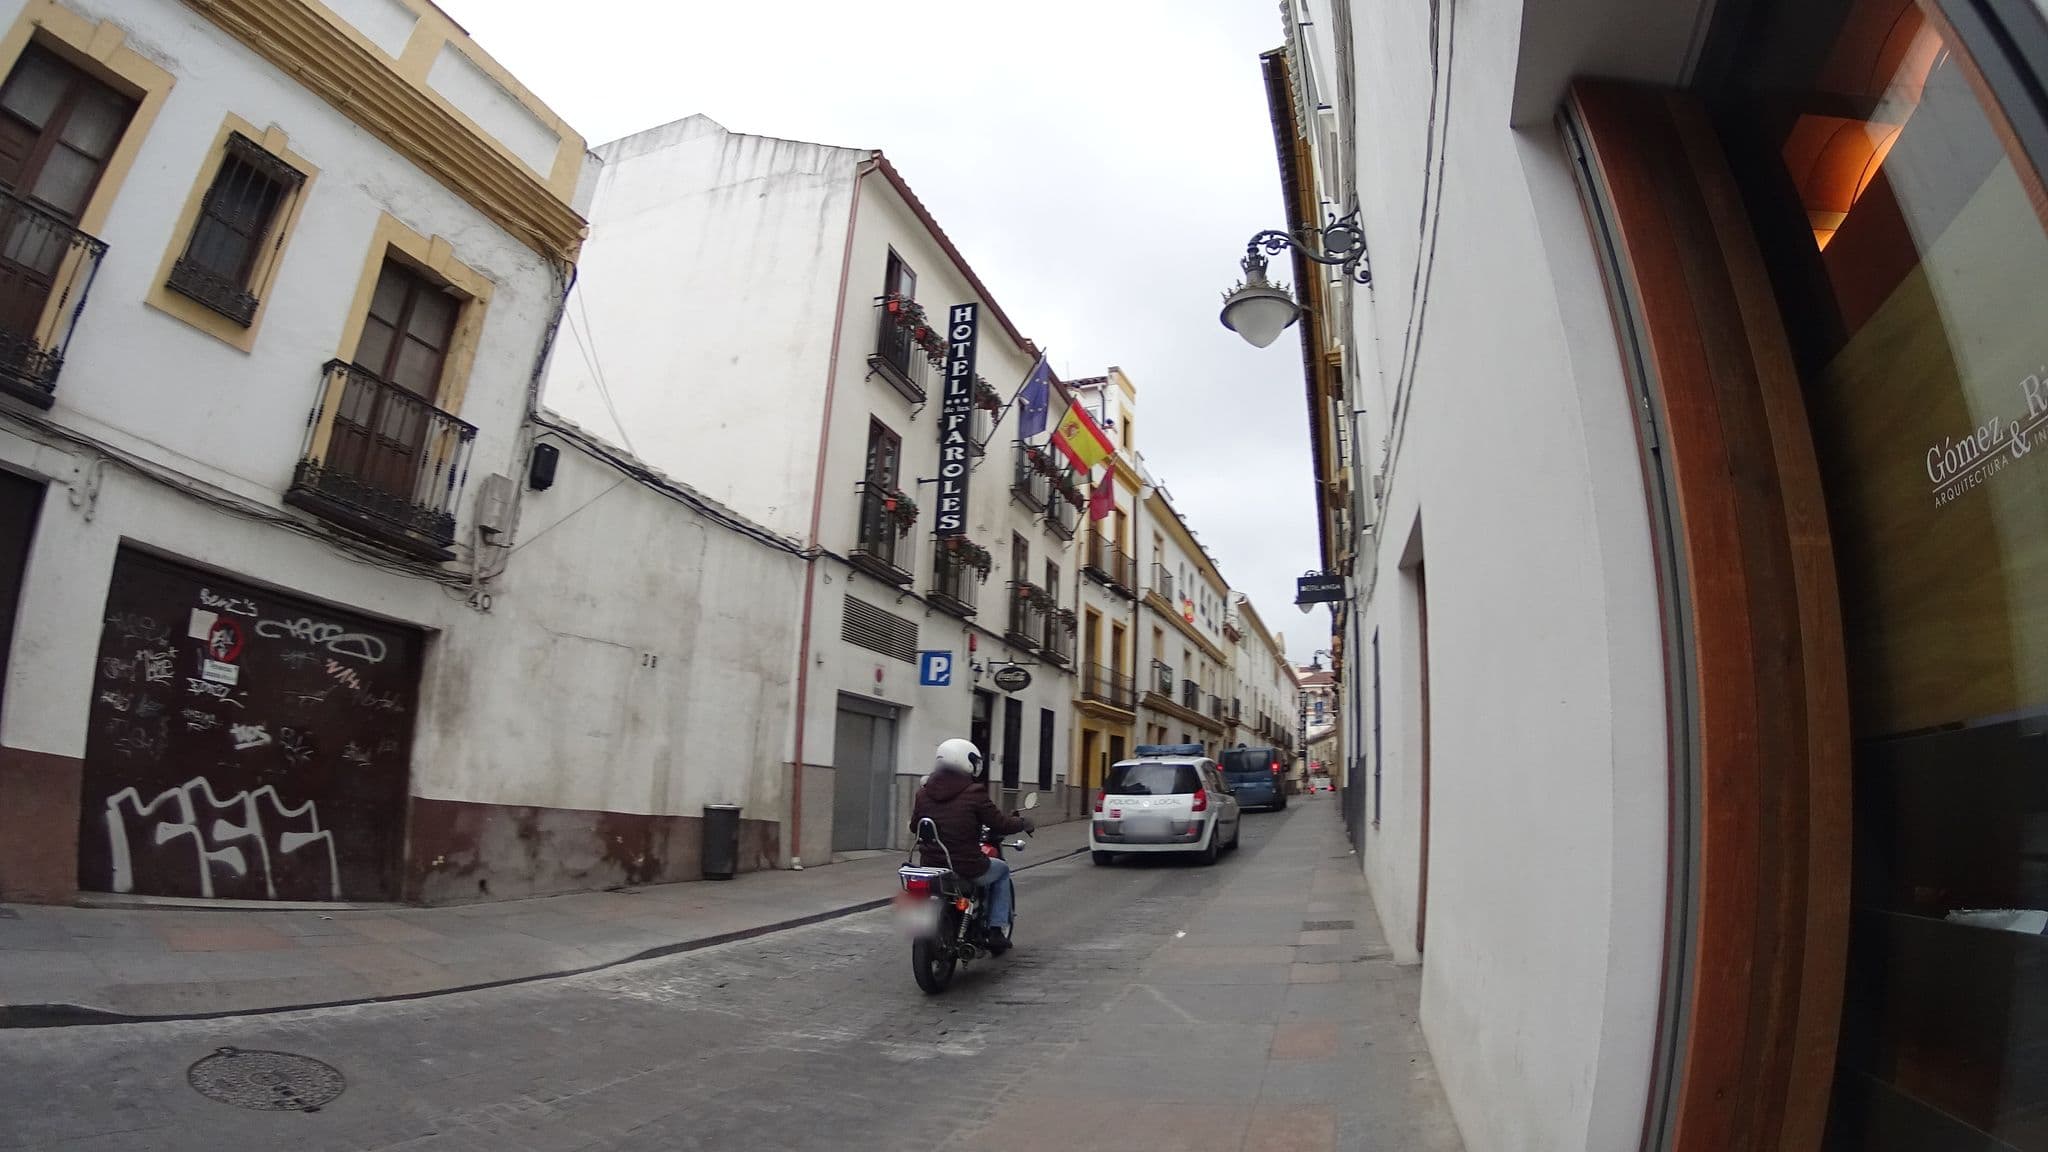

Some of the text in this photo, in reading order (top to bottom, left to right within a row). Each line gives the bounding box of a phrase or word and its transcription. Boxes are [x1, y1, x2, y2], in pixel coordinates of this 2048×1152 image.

[950, 306, 973, 395] HOTEL
[939, 414, 967, 529] FAROLES
[1926, 416, 2003, 483] Gómez
[2010, 420, 2032, 458] &
[1935, 455, 2009, 509] ARQUITECTURA
[928, 656, 949, 681] P
[1153, 798, 1183, 806] LOCAL
